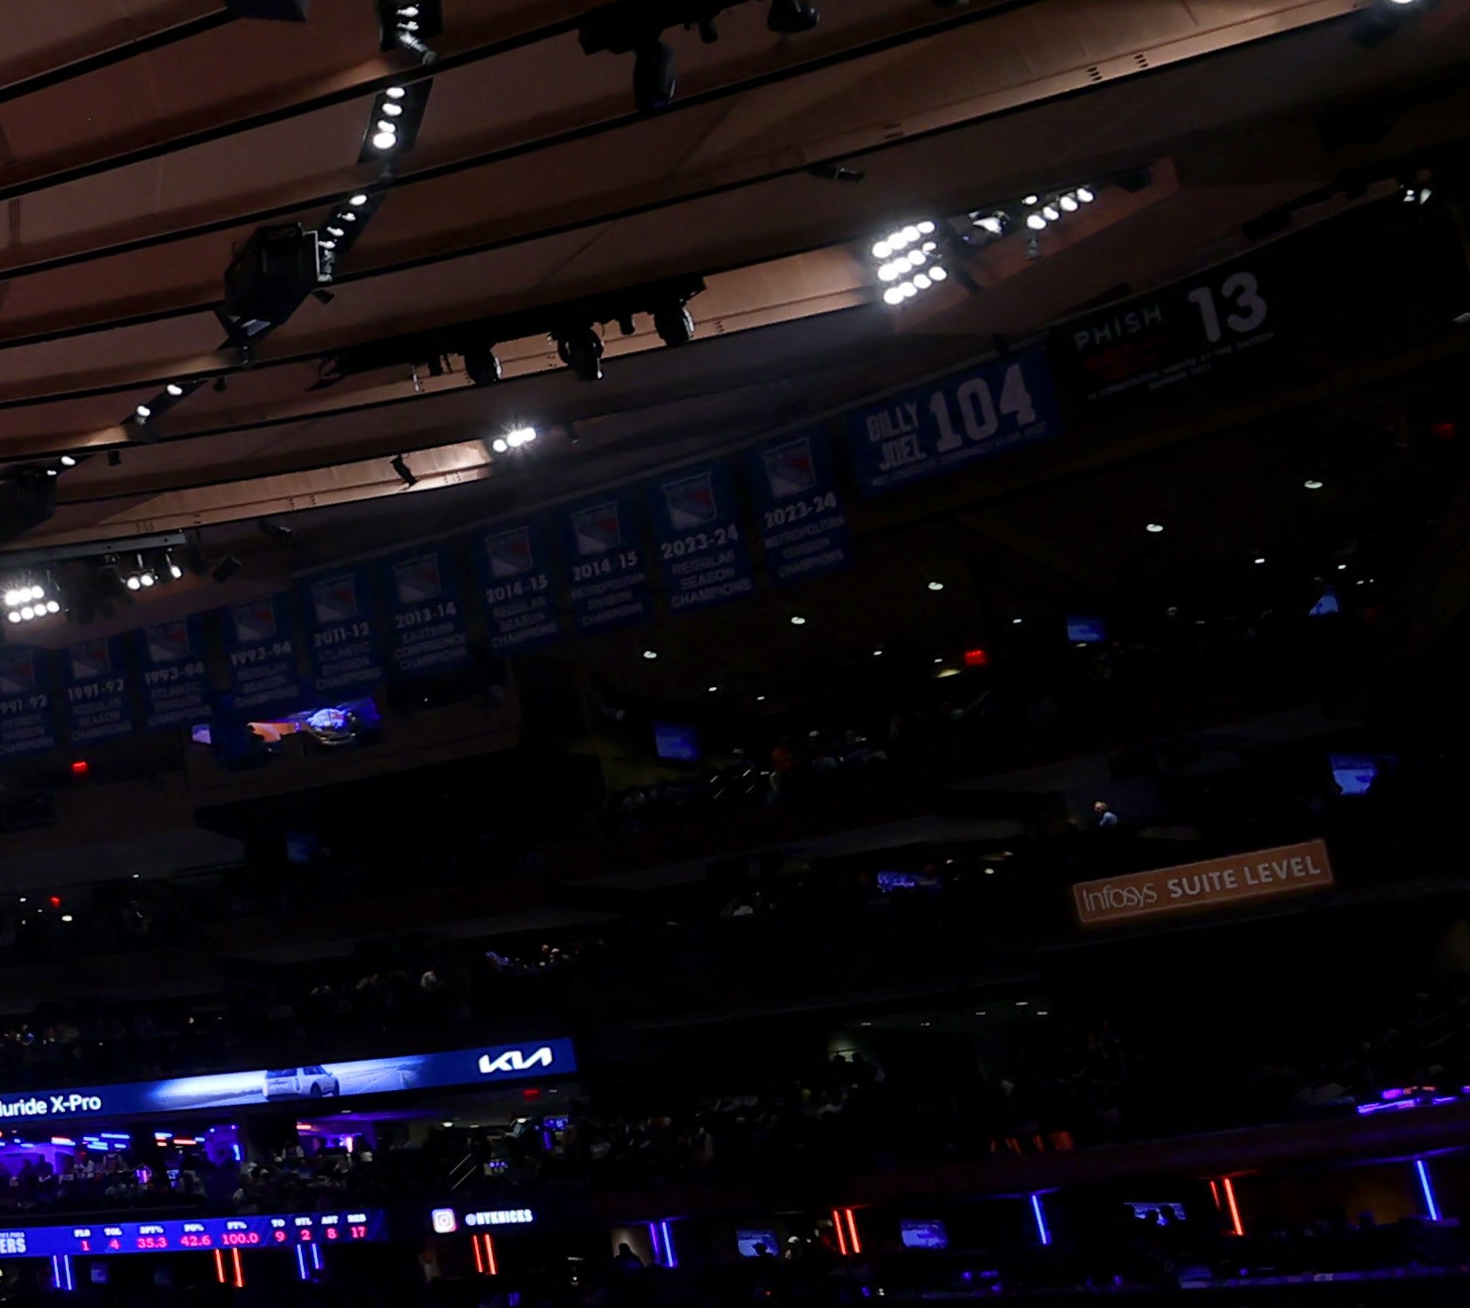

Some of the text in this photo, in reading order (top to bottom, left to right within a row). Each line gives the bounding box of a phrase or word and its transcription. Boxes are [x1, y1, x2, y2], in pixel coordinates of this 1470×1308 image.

[1188, 272, 1268, 343] 13
[1074, 303, 1163, 352] PHISH
[865, 401, 922, 443] BILLY
[929, 363, 1037, 454] 104
[880, 438, 926, 472] JOEL
[1083, 855, 1321, 912] Infosys SUITE LEVEL
[479, 1047, 552, 1073] KIA
[52, 1095, 101, 1113] X-Pro
[465, 1209, 533, 1226] @NYKNICKS
[137, 1226, 366, 1249] 35.3 42.6 100.0 17
